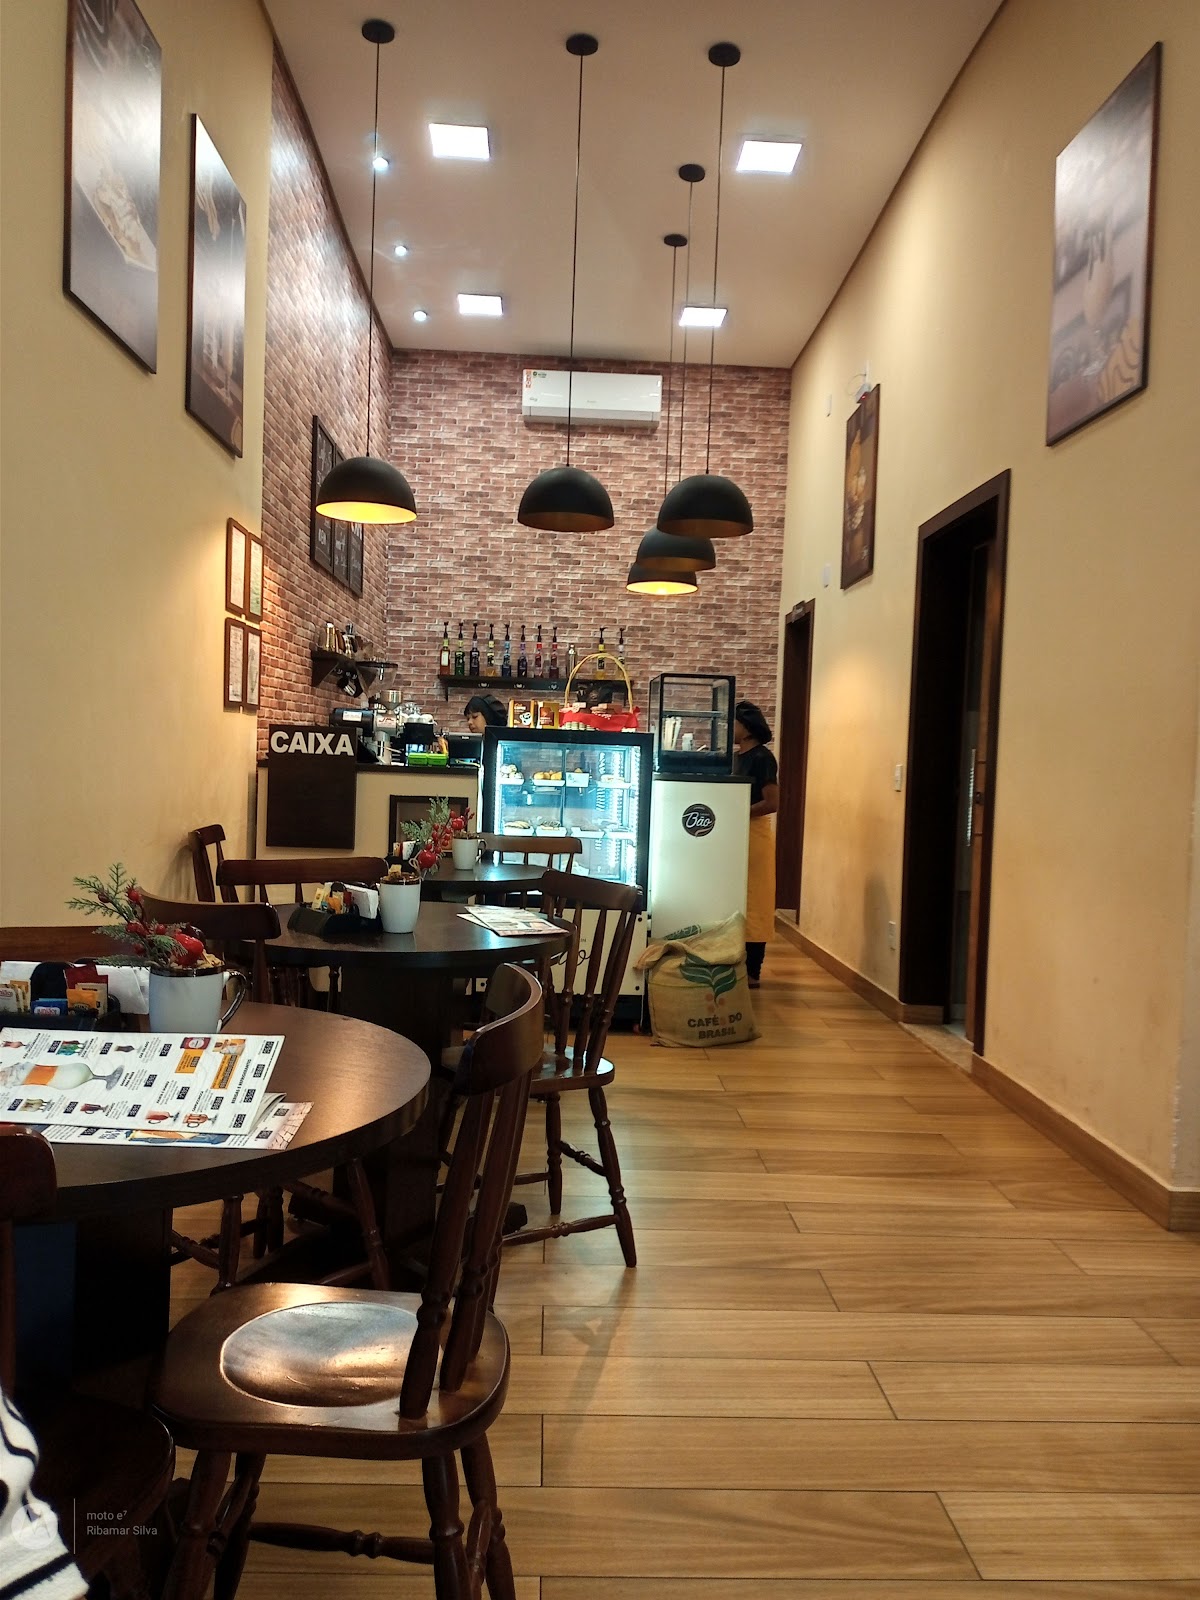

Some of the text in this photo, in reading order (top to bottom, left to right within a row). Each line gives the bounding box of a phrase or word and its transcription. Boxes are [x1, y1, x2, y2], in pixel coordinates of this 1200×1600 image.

[270, 731, 354, 756] CAIXA
[682, 811, 713, 829] Bão
[687, 1012, 742, 1028] CAFÉ DO
[698, 1026, 736, 1039] BRASIL
